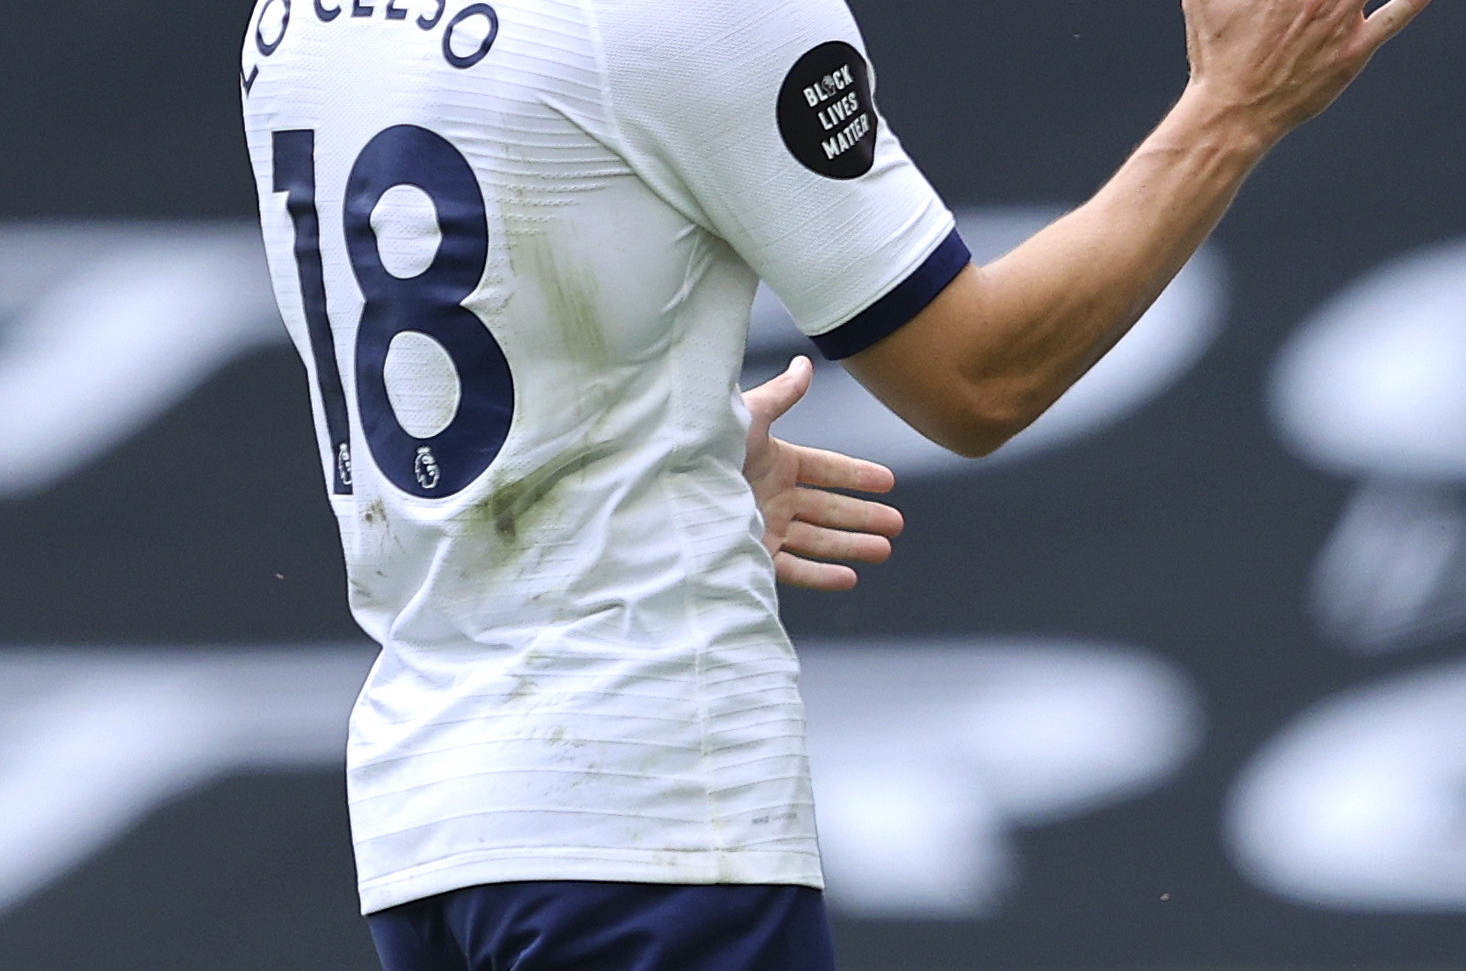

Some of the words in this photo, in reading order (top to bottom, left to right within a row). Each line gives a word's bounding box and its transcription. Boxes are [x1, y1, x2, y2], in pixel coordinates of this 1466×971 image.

[803, 64, 854, 108] BLCK
[818, 91, 859, 131] LIVES
[821, 113, 871, 160] MATTER
[272, 123, 516, 500] 18
